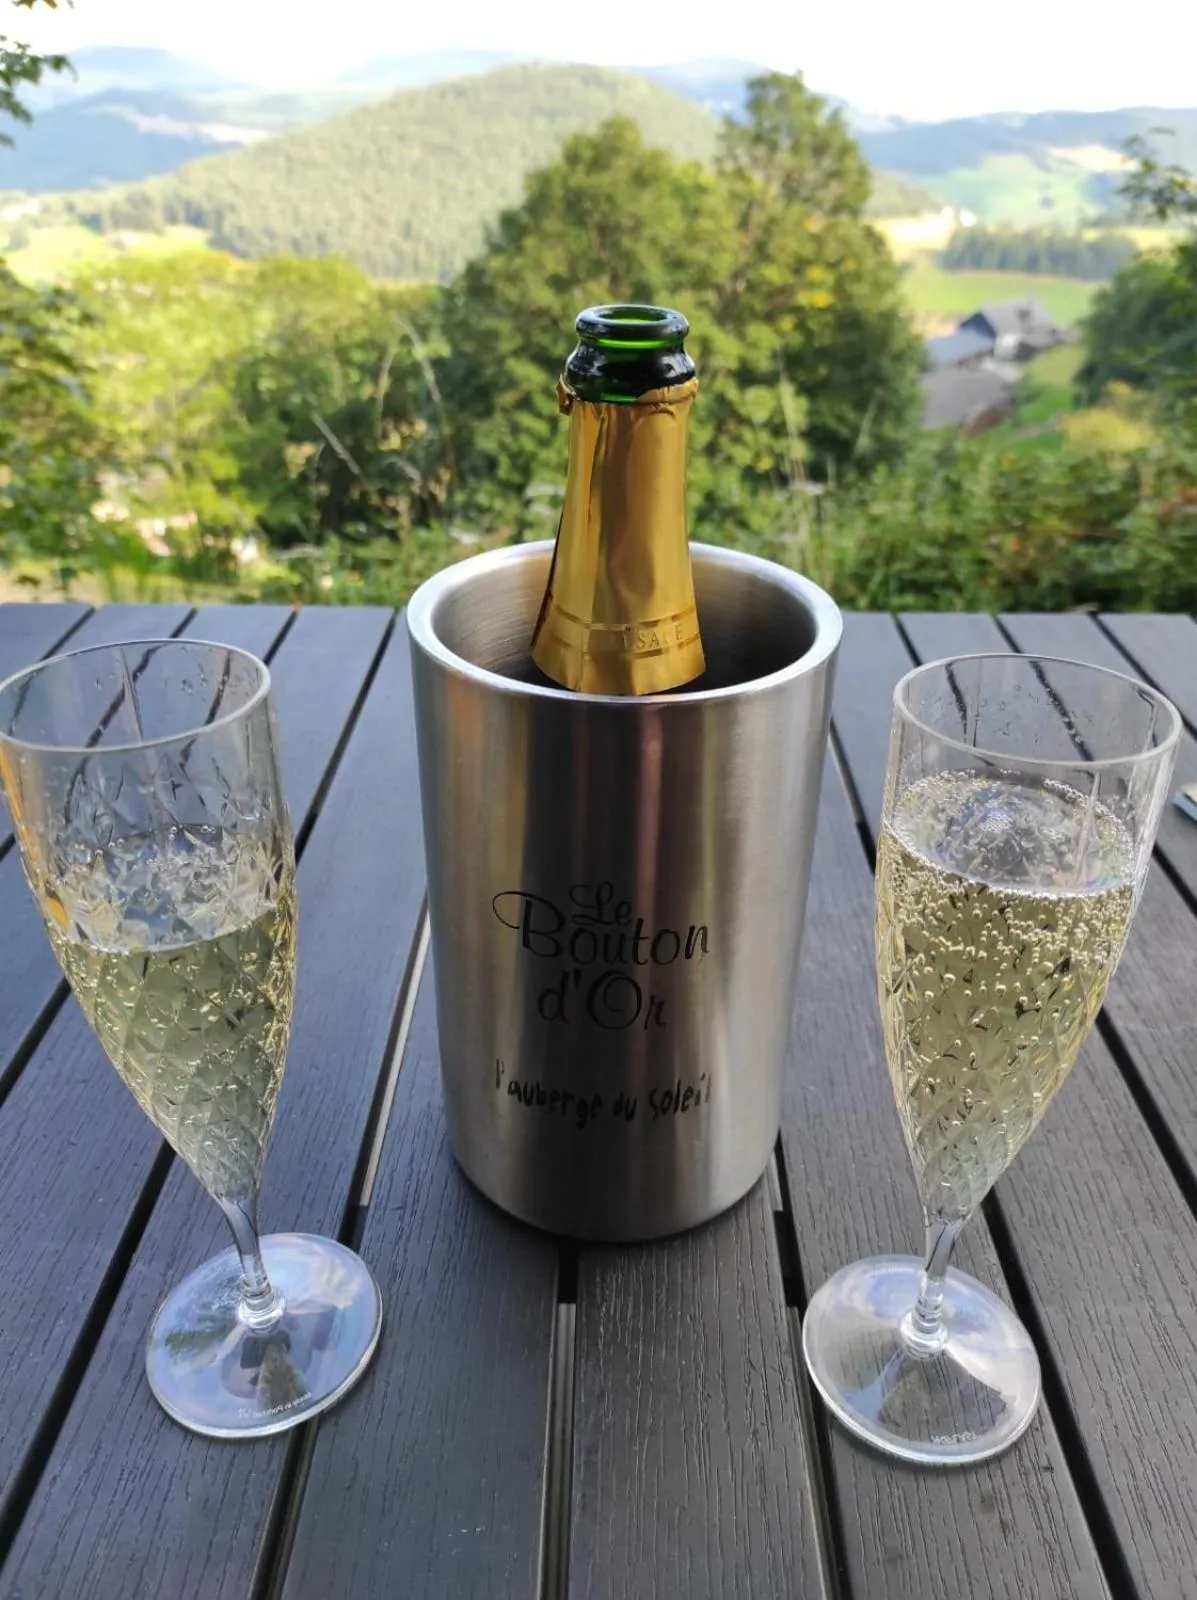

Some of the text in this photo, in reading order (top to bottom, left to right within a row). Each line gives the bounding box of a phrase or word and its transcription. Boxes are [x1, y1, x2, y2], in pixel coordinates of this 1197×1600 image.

[492, 890, 711, 967] Bouton
[569, 880, 634, 928] Le
[537, 968, 668, 1031] d'Or
[612, 1092, 638, 1122] du
